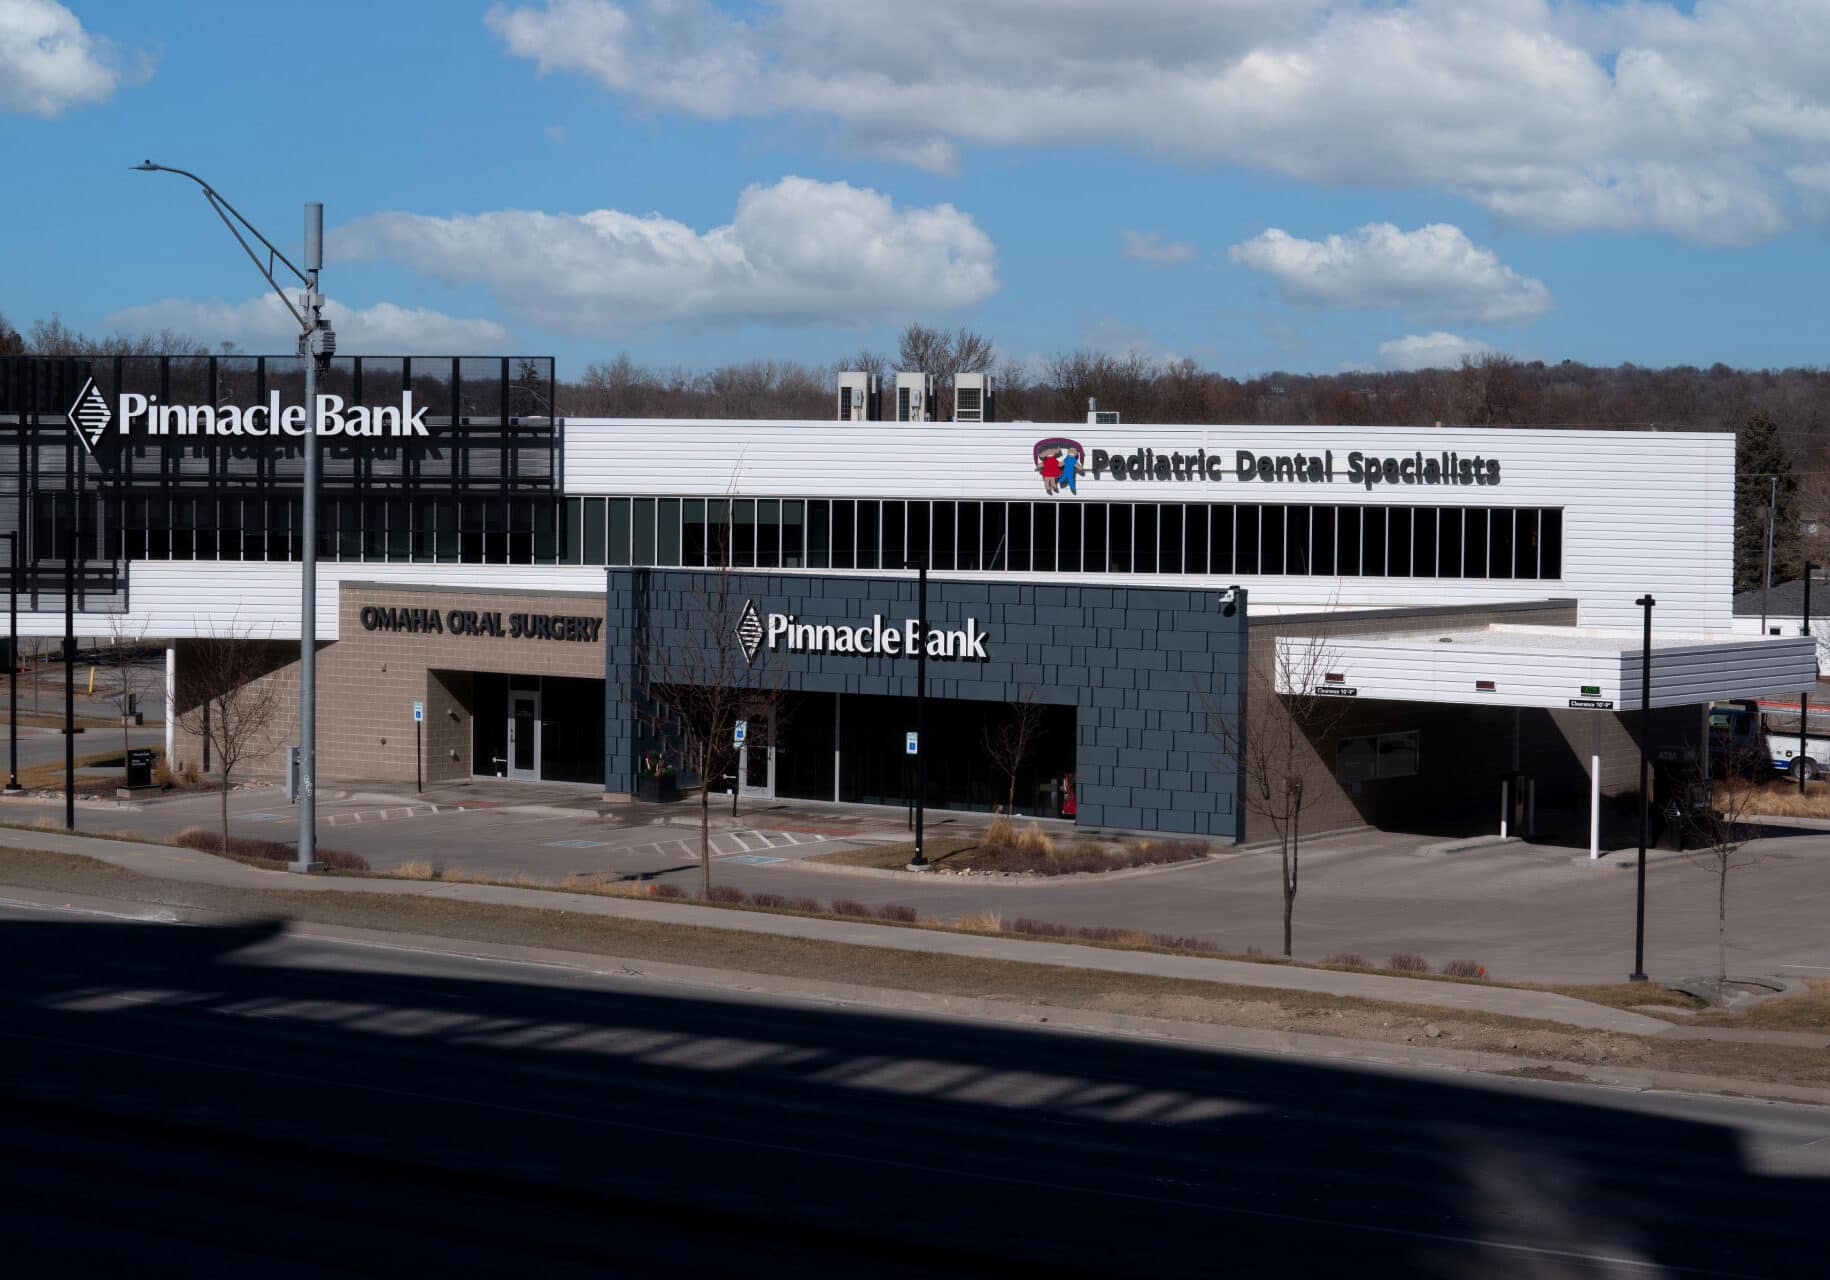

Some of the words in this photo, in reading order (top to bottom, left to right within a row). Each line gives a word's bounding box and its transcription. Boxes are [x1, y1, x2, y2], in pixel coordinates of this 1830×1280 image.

[119, 389, 307, 437] Pinnacle
[316, 390, 430, 437] Bank
[1092, 448, 1222, 482] Pediatric
[1236, 450, 1333, 483] Dental
[1347, 450, 1501, 491] Specialists
[360, 606, 443, 634] OMAHA
[446, 609, 506, 638] ORAL
[508, 613, 603, 643] SURGERY
[768, 614, 901, 655] Pinnacle
[905, 617, 988, 658] Bank
